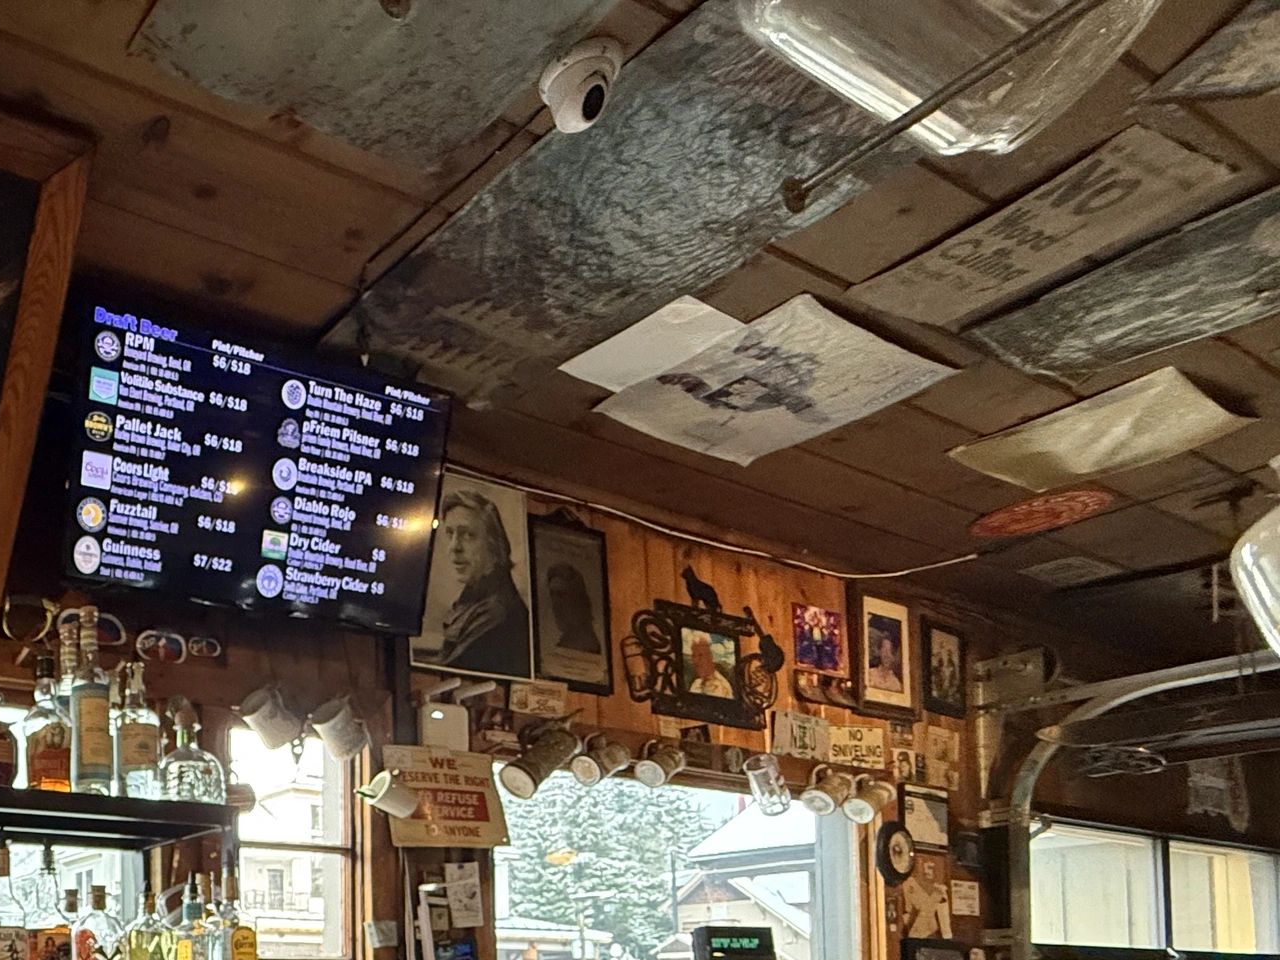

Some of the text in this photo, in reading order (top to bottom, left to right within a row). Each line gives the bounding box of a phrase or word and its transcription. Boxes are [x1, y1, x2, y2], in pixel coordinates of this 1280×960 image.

[94, 306, 178, 342] Draft Beer
[125, 332, 155, 352] RPM
[212, 354, 252, 375] $6/$18
[155, 379, 205, 402] Substance
[309, 380, 333, 398] Turn
[334, 387, 354, 404] The
[355, 393, 382, 411] Haze
[209, 391, 248, 412] $6/$18
[390, 402, 424, 421] $6/$18
[116, 414, 182, 441] Pallet Jack
[302, 420, 341, 439] pFriem
[342, 428, 380, 448] Pilsner
[204, 433, 243, 452] $6/$18
[385, 438, 420, 457] $6/$18
[113, 457, 169, 481] Coors Light
[298, 457, 353, 481] Breakside
[354, 471, 372, 486] IPA
[201, 476, 238, 495] $6/$1
[380, 476, 415, 494] $6/$18
[109, 499, 158, 520] Fuzztail
[294, 496, 329, 516] Diablo
[331, 504, 356, 521] Rojo
[197, 515, 236, 533] $6/$18
[376, 514, 407, 530] $6/$1
[102, 537, 161, 560] Guinness
[290, 533, 341, 554] Dry Cider
[193, 554, 232, 572] $7/$22
[372, 548, 386, 562] $8
[285, 566, 342, 591] Strawberry
[342, 576, 369, 593] Cider
[371, 581, 385, 595] $8
[848, 729, 863, 742] NO
[832, 744, 882, 759] SNIVELING
[428, 756, 459, 770] WE
[443, 773, 461, 786] THE
[464, 775, 490, 789] RIGHT
[436, 791, 480, 806] REFUSE
